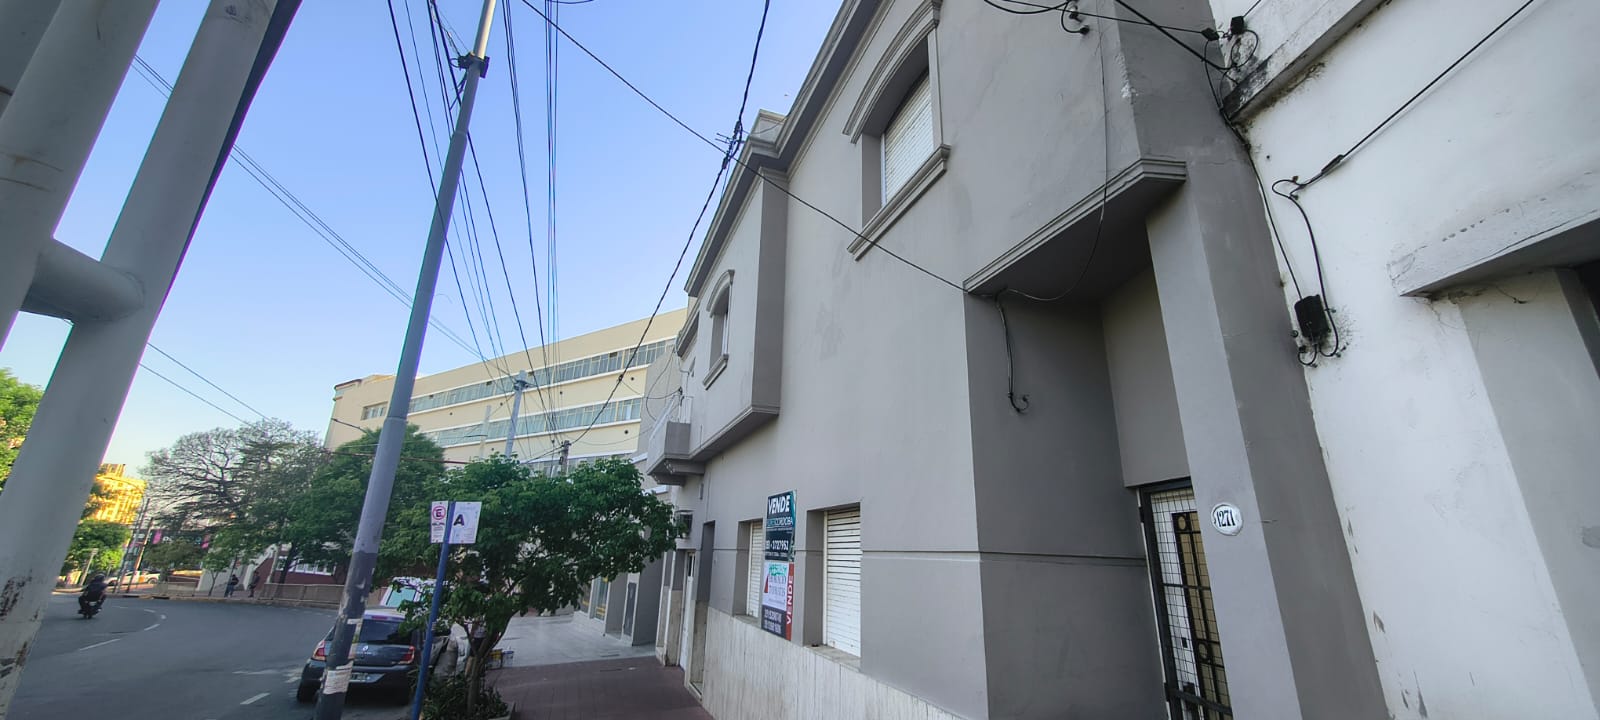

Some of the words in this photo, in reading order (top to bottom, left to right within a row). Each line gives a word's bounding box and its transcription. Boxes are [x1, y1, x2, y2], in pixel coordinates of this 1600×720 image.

[768, 495, 790, 515] VENDE
[454, 514, 464, 526] A
[1216, 510, 1236, 527] 1271
[786, 575, 794, 625] VENDE
